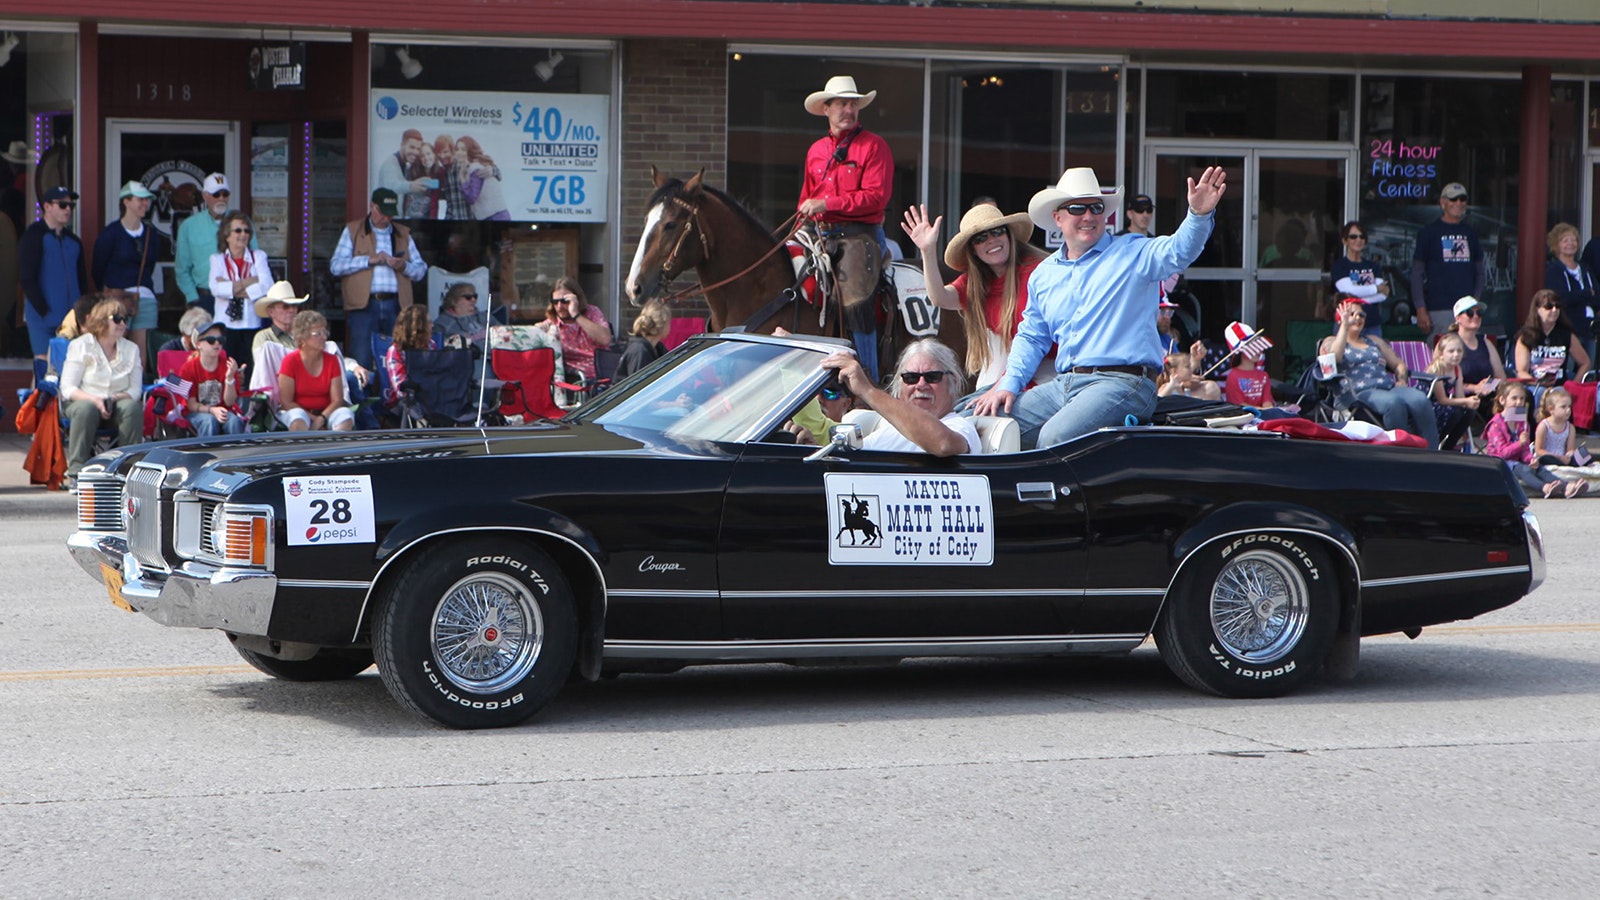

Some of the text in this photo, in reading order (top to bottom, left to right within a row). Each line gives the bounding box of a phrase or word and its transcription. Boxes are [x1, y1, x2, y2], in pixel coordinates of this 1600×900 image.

[137, 84, 191, 100] 1318
[400, 104, 503, 119] Selectel Wireless
[523, 145, 597, 157] UNLIMITED
[1371, 139, 1442, 159] 24 hour
[1372, 160, 1436, 178] Fitness
[533, 175, 587, 206] 7GB
[1378, 179, 1431, 197] Center
[904, 480, 961, 499] MAYOR
[310, 498, 352, 525] 28
[886, 504, 984, 533] MATT HALL
[324, 527, 357, 540] pepsi
[894, 535, 978, 561] City of Cody
[1221, 534, 1320, 580] BFGoodrich
[638, 555, 686, 573] Cougar
[467, 555, 550, 595] Radial T/A
[1209, 643, 1297, 680] Radial T/A
[423, 661, 524, 710] BFGoodrich
